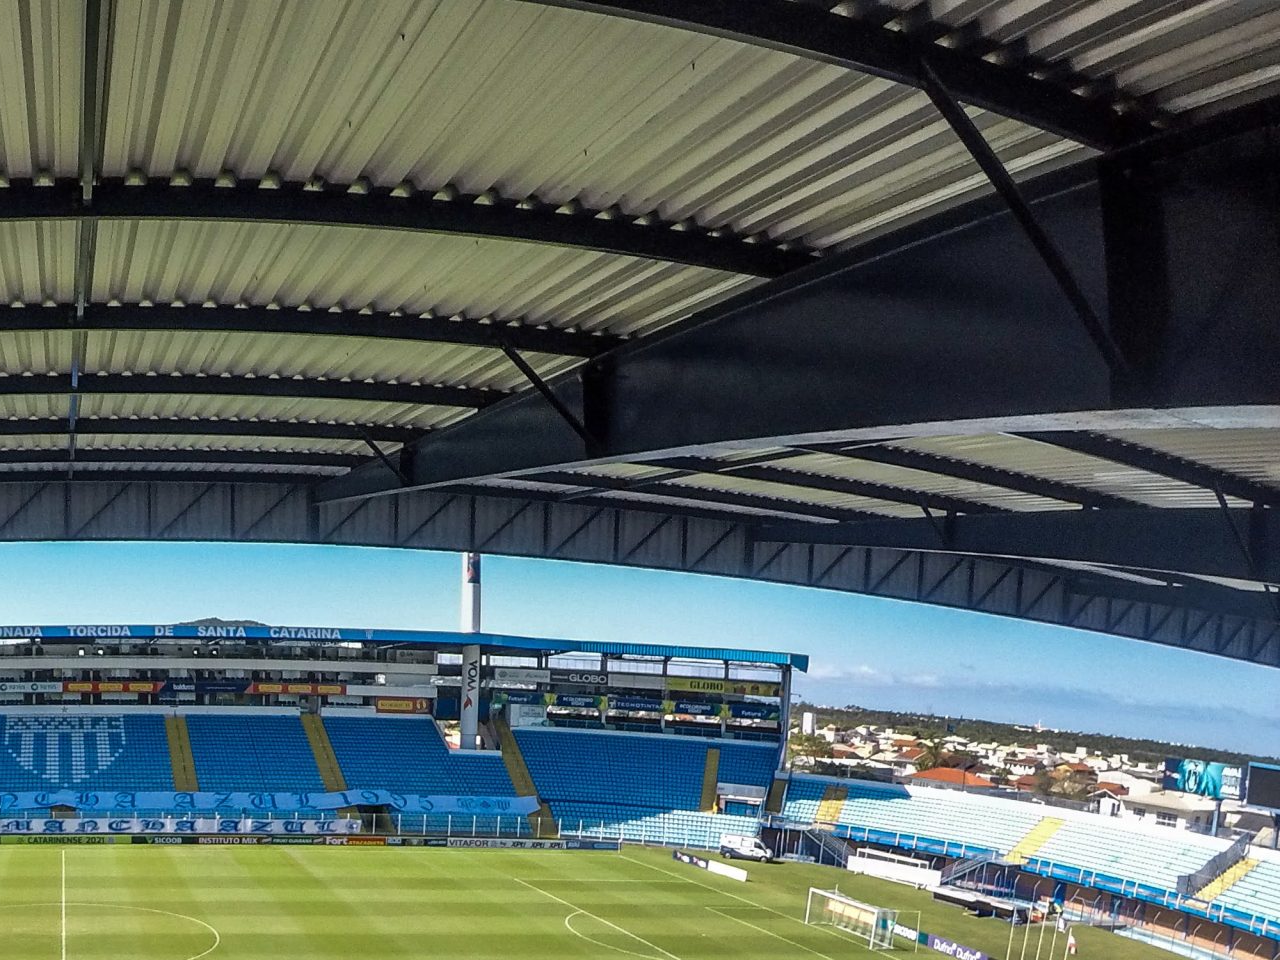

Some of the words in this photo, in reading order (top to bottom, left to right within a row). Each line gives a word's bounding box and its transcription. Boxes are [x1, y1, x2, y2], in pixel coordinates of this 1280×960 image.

[67, 626, 131, 637] TORCIDA
[154, 626, 174, 637] DE
[197, 626, 247, 637] SANTA
[270, 627, 341, 639] CATARINA
[569, 673, 607, 684] GLOBO
[689, 680, 723, 691] GLOBO
[173, 792, 317, 810] AZUL
[0, 819, 197, 833] MANCHA
[218, 819, 337, 833] AZUL
[27, 836, 83, 844] CATARINENSE
[86, 836, 105, 844] 2021
[154, 836, 182, 844] SICOOB
[198, 836, 240, 844] INSTITUTO
[241, 836, 258, 844] MIX
[325, 836, 348, 845] Fort
[449, 839, 489, 848] VITAFOR
